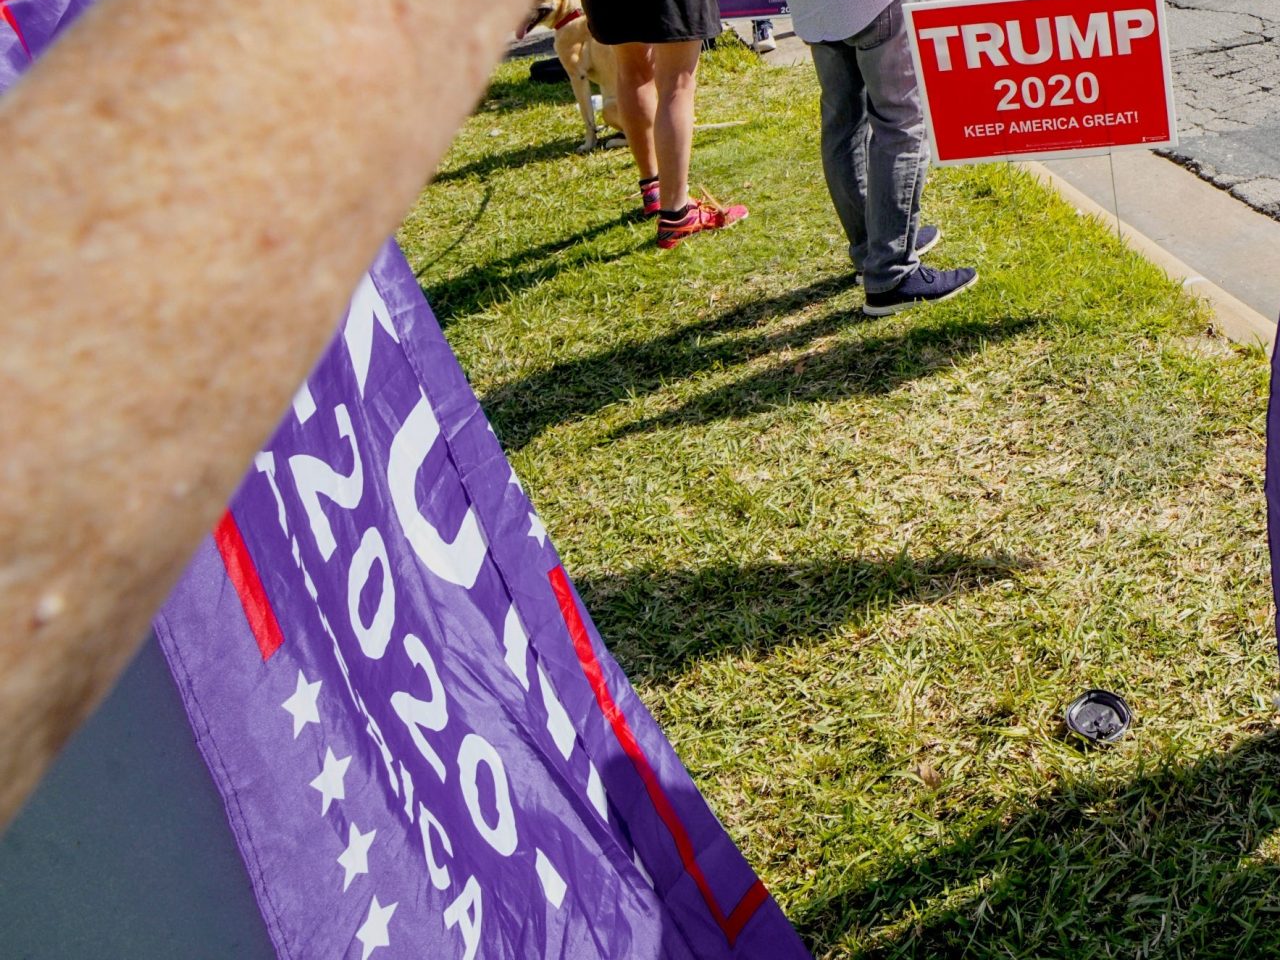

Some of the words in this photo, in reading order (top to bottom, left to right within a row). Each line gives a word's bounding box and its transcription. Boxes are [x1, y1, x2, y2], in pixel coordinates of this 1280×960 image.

[918, 8, 1156, 73] TRUMP
[993, 71, 1100, 112] 2020
[964, 123, 1005, 139] KEEP
[1008, 116, 1080, 135] AMERICA
[1081, 110, 1140, 129] GREAT!
